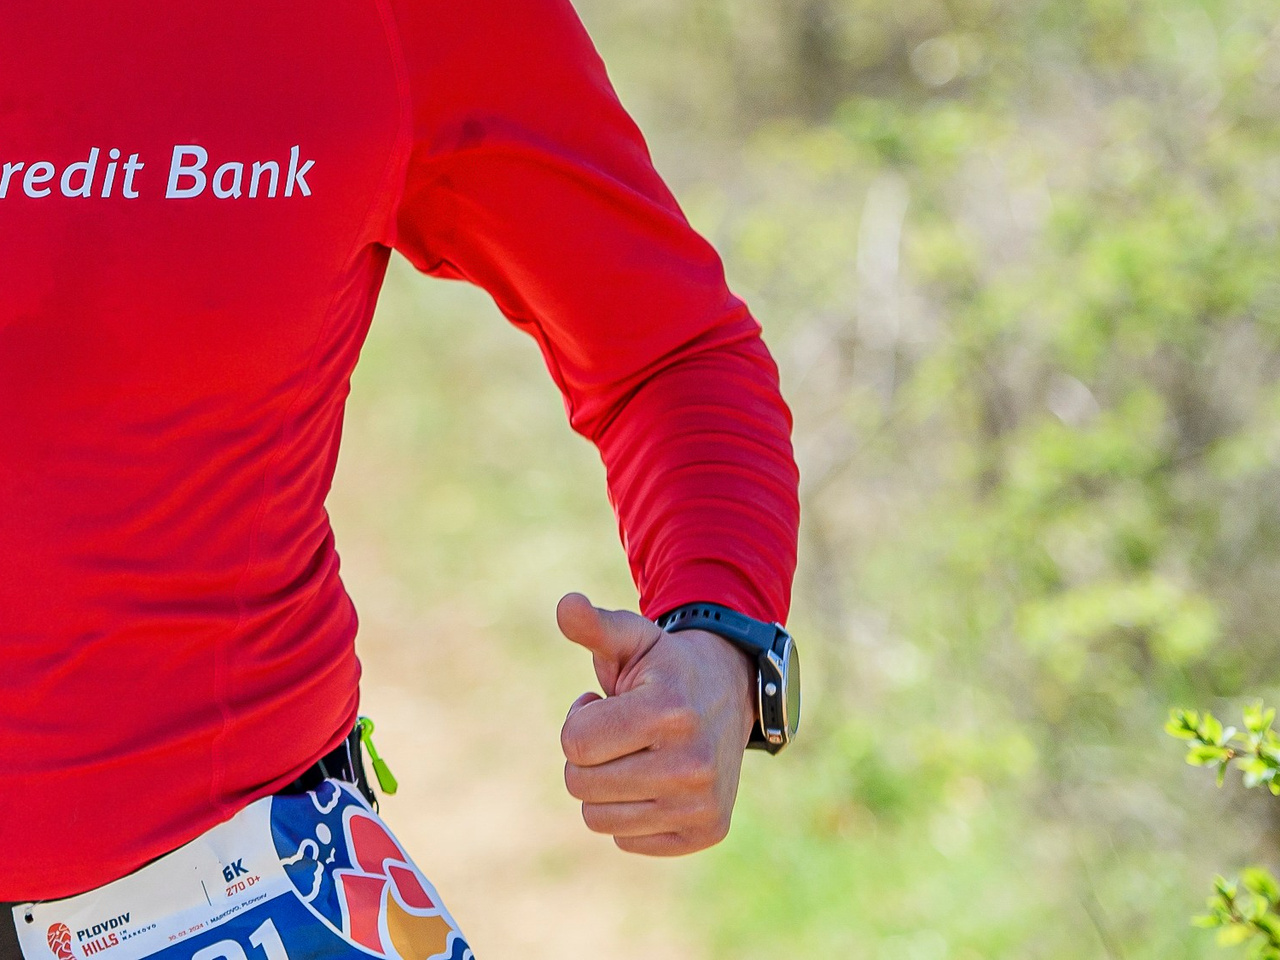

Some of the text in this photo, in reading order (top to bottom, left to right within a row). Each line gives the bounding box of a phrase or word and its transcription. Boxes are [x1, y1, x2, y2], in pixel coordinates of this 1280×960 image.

[164, 145, 315, 199] Bank
[222, 858, 249, 883] 6K
[225, 875, 260, 897] 270 D+
[76, 912, 130, 941] PLOVDIV
[122, 923, 157, 940] MARKOVO
[81, 933, 119, 957] HILLS
